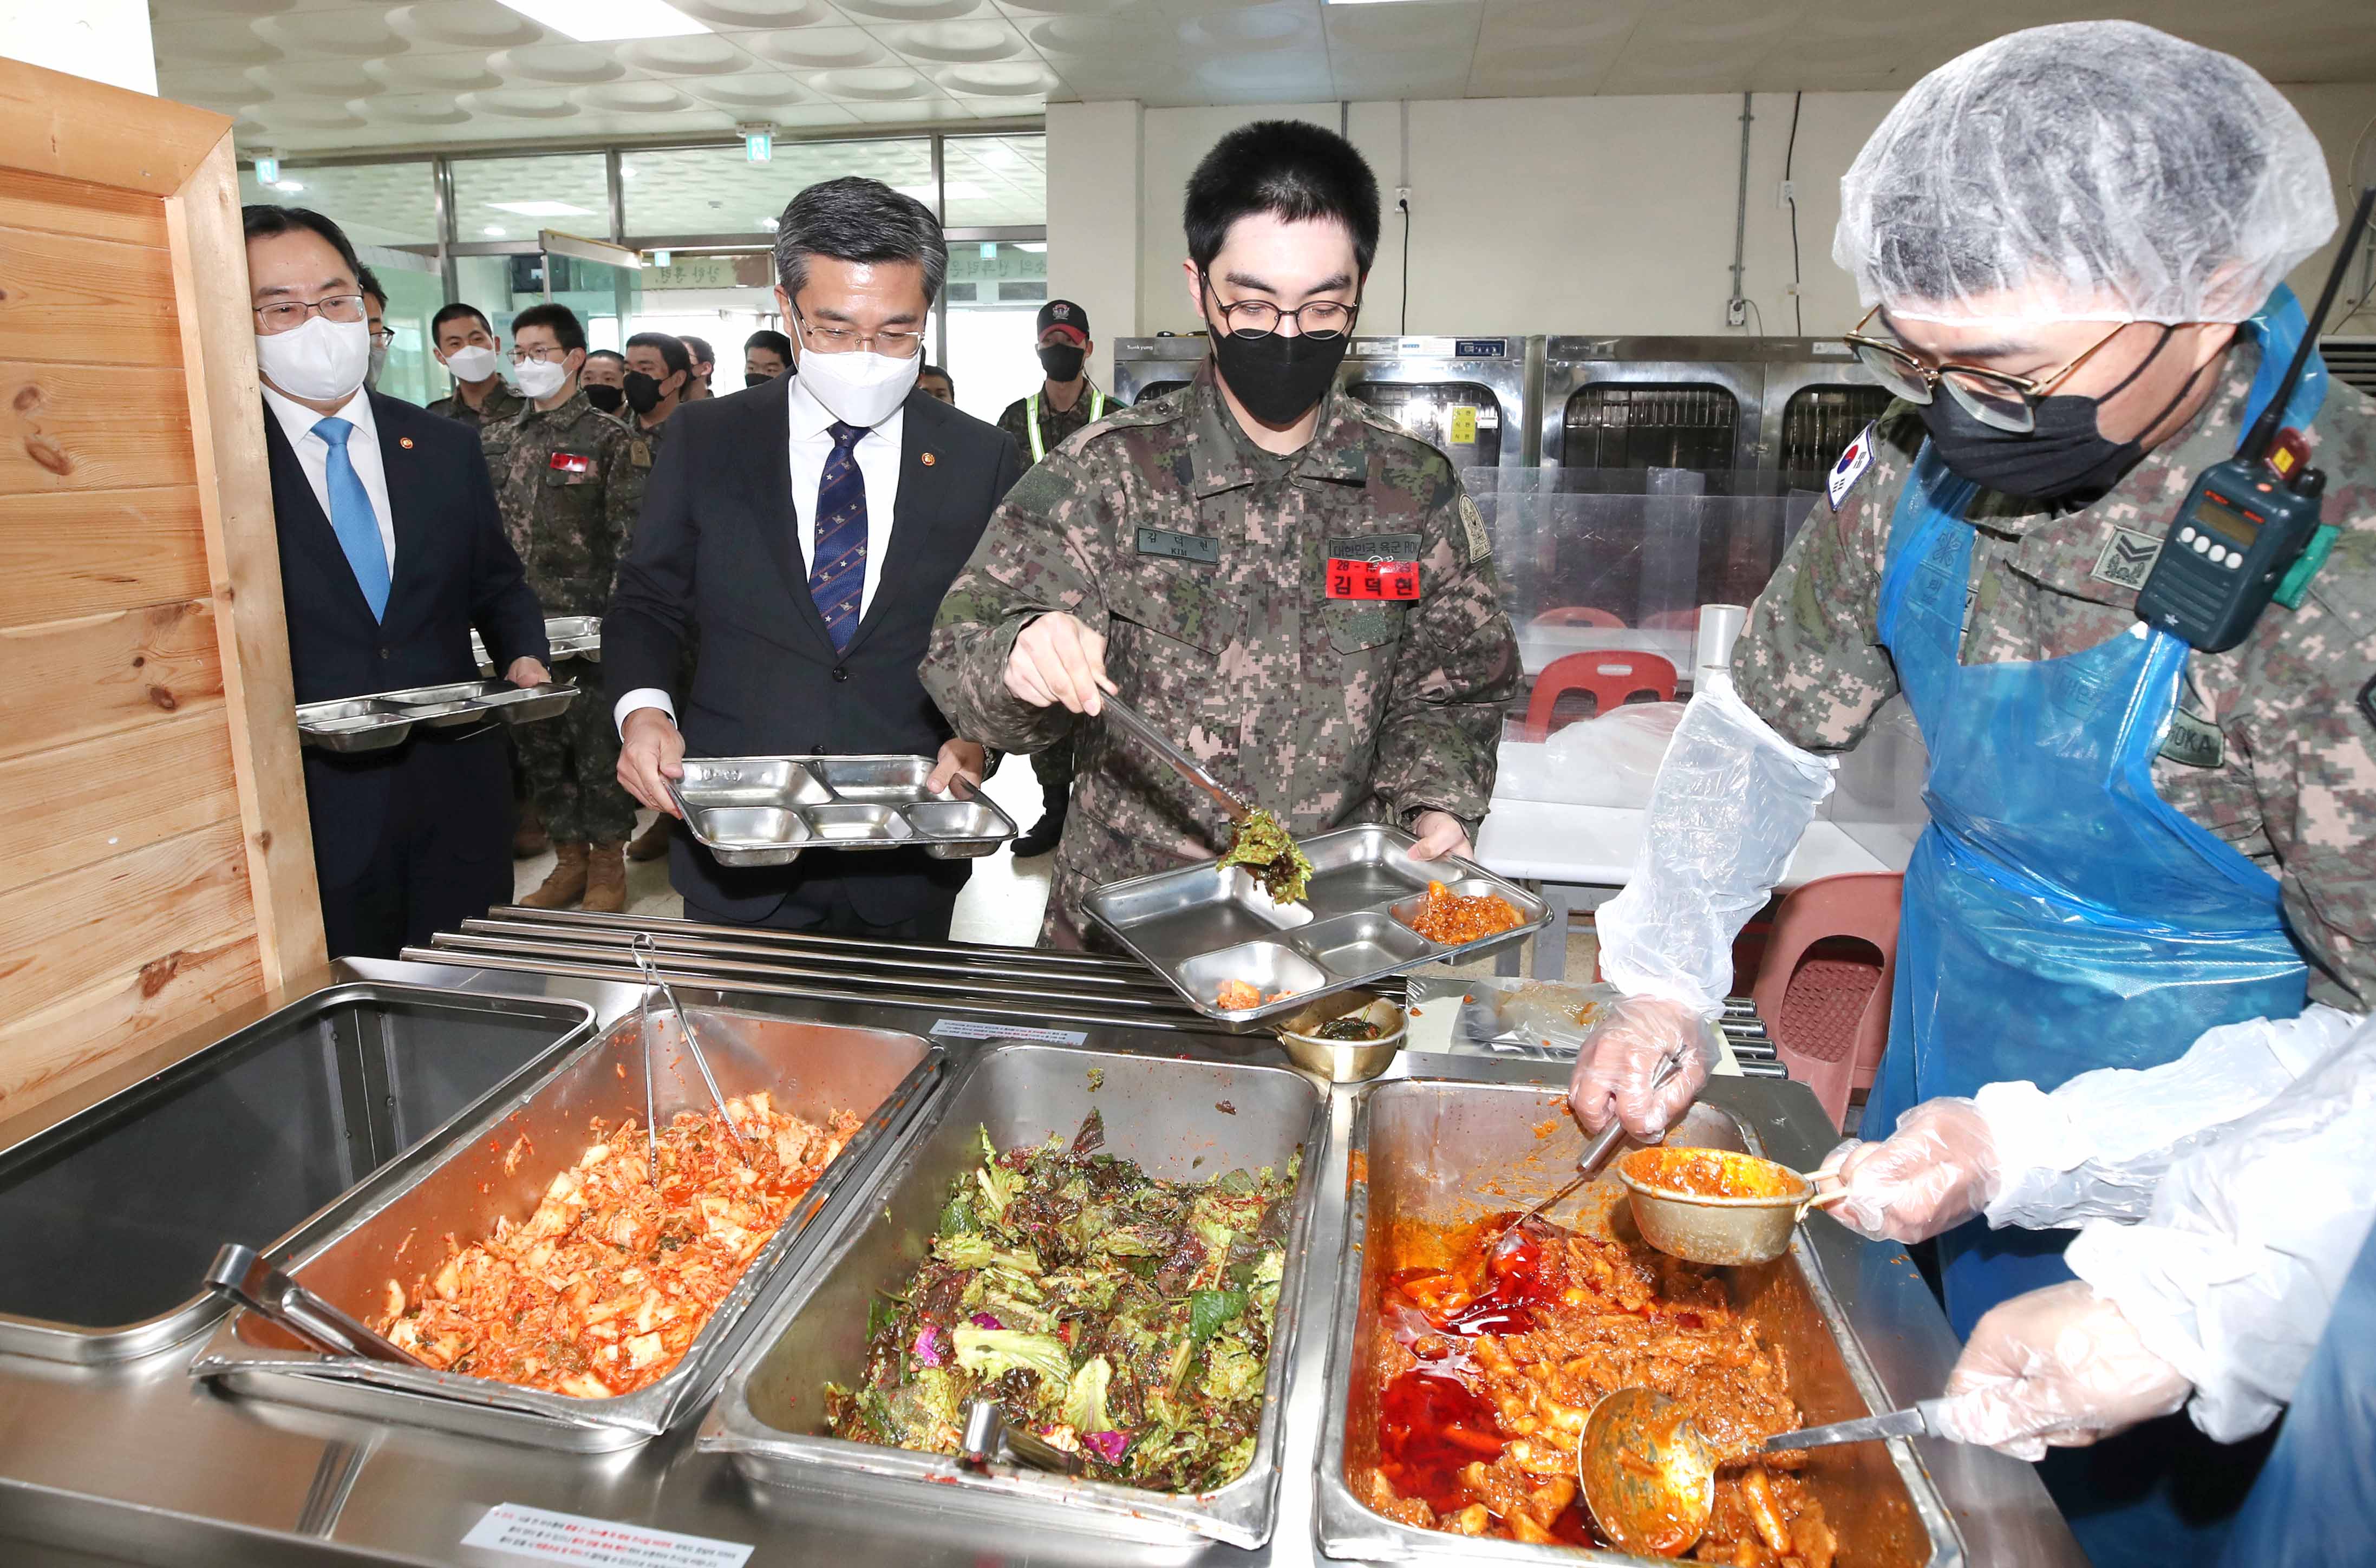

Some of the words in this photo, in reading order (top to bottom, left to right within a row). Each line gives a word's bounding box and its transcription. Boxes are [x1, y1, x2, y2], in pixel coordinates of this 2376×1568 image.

[1171, 547, 1187, 557] KIM
[1333, 543, 1375, 557] 대한민국
[1380, 541, 1401, 554] 육군
[1336, 560, 1350, 571] 28
